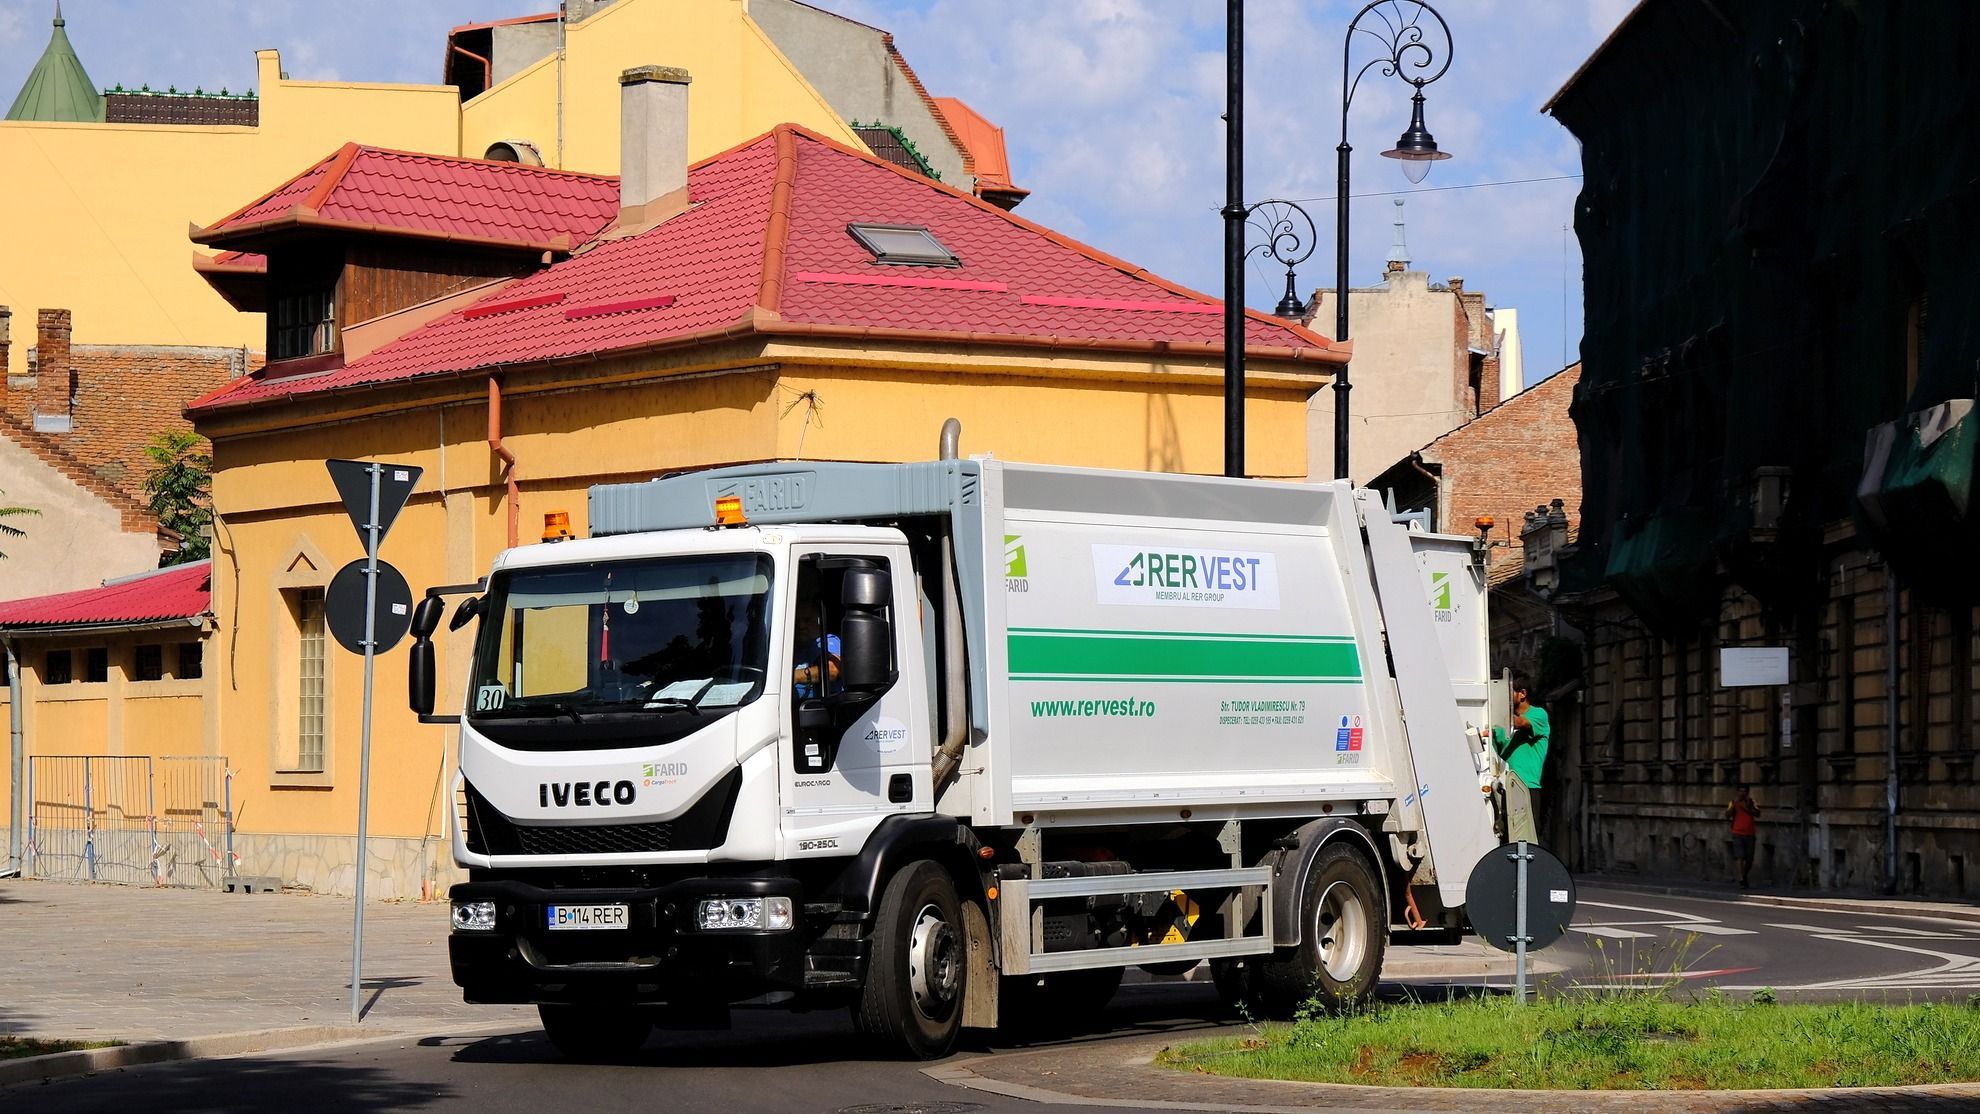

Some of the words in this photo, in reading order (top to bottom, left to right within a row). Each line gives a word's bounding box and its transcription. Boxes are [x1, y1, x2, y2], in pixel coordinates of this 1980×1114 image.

[745, 478, 807, 512] FARID
[1155, 591, 1181, 600] MEMBRU
[1182, 592, 1190, 600] AL
[1191, 592, 1203, 601] RER
[1204, 592, 1225, 601] GROUP
[1435, 610, 1451, 622] FARID
[480, 689, 502, 711] 30
[1031, 696, 1155, 717] www.rervest.ro
[1221, 701, 1230, 711] Str.
[1232, 701, 1249, 711] TUDOR
[1299, 701, 1305, 711] 79
[1343, 753, 1359, 764] FARID
[655, 763, 688, 777] FARID
[539, 780, 637, 807] IVECO
[558, 908, 567, 924] B
[572, 908, 590, 924] 114
[593, 908, 623, 924] RER
